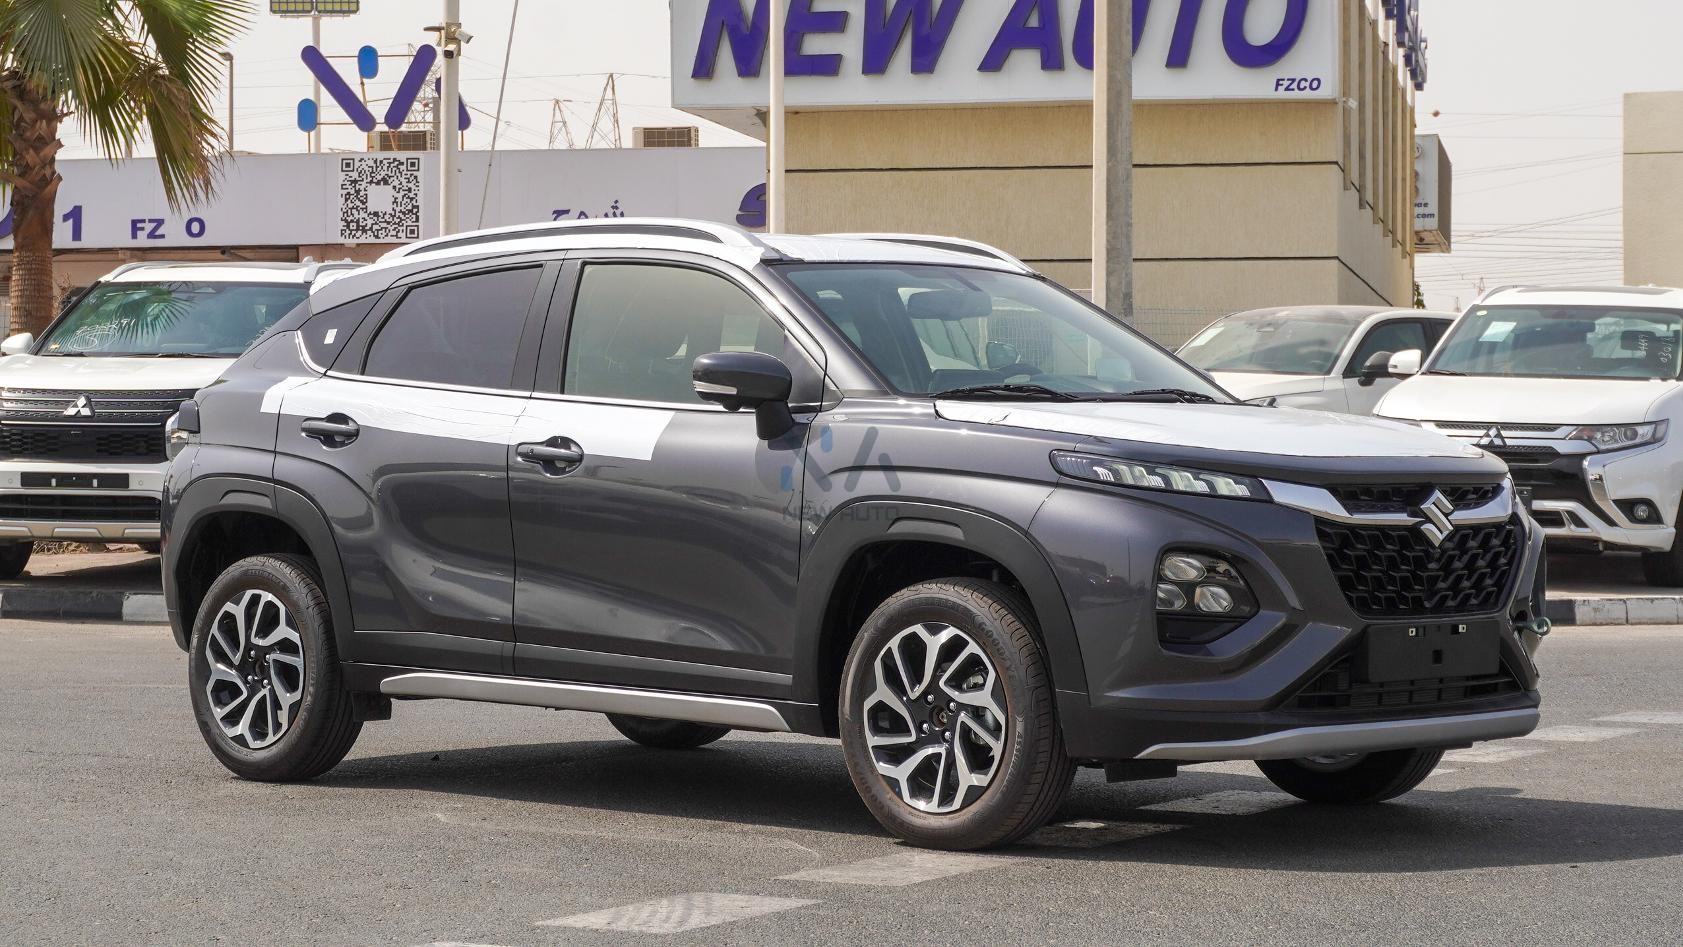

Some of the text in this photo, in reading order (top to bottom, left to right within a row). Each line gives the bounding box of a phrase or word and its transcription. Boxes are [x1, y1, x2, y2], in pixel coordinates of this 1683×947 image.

[691, 0, 967, 79] NEW
[1274, 77, 1322, 92] FZCO
[62, 205, 83, 242] 1
